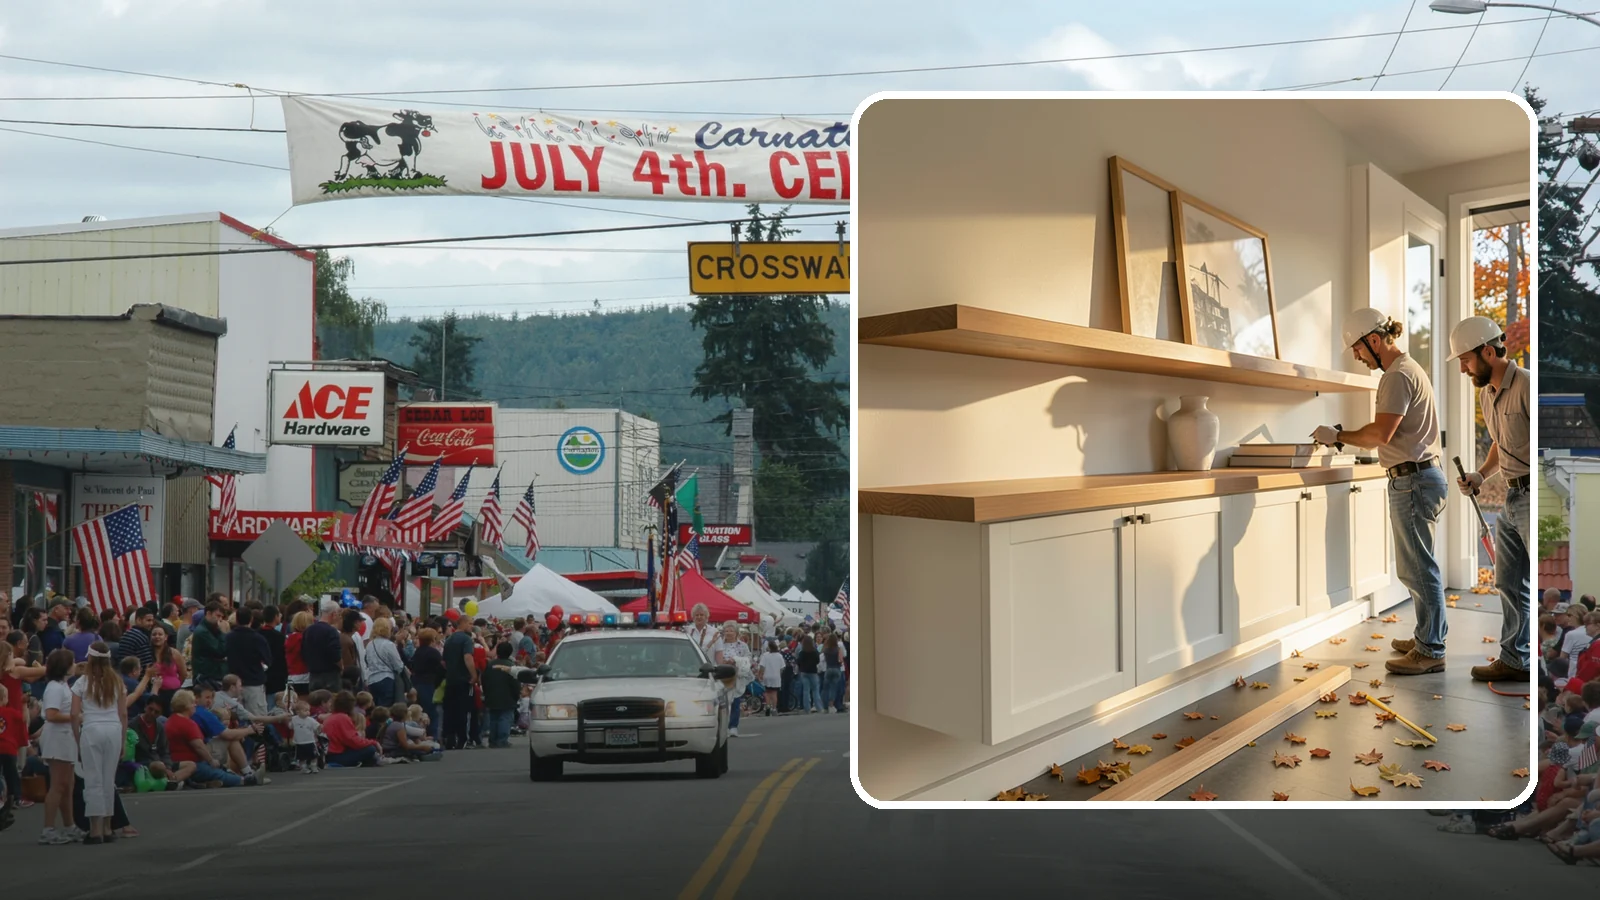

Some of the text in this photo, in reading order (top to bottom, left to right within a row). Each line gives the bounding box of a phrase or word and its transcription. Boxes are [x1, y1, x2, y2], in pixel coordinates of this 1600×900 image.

[481, 141, 605, 192] JULY
[632, 150, 746, 198] 4th.
[697, 254, 850, 280] CROSSWA
[283, 380, 373, 420] ACE
[405, 409, 452, 422] CEDAR
[284, 421, 371, 436] Hardware
[416, 427, 477, 447] Coca-Cola
[354, 467, 385, 480] Simpl
[83, 484, 155, 495] St. Vincent de Paul
[688, 526, 742, 535] CRNATION
[699, 535, 730, 543] GLASS
